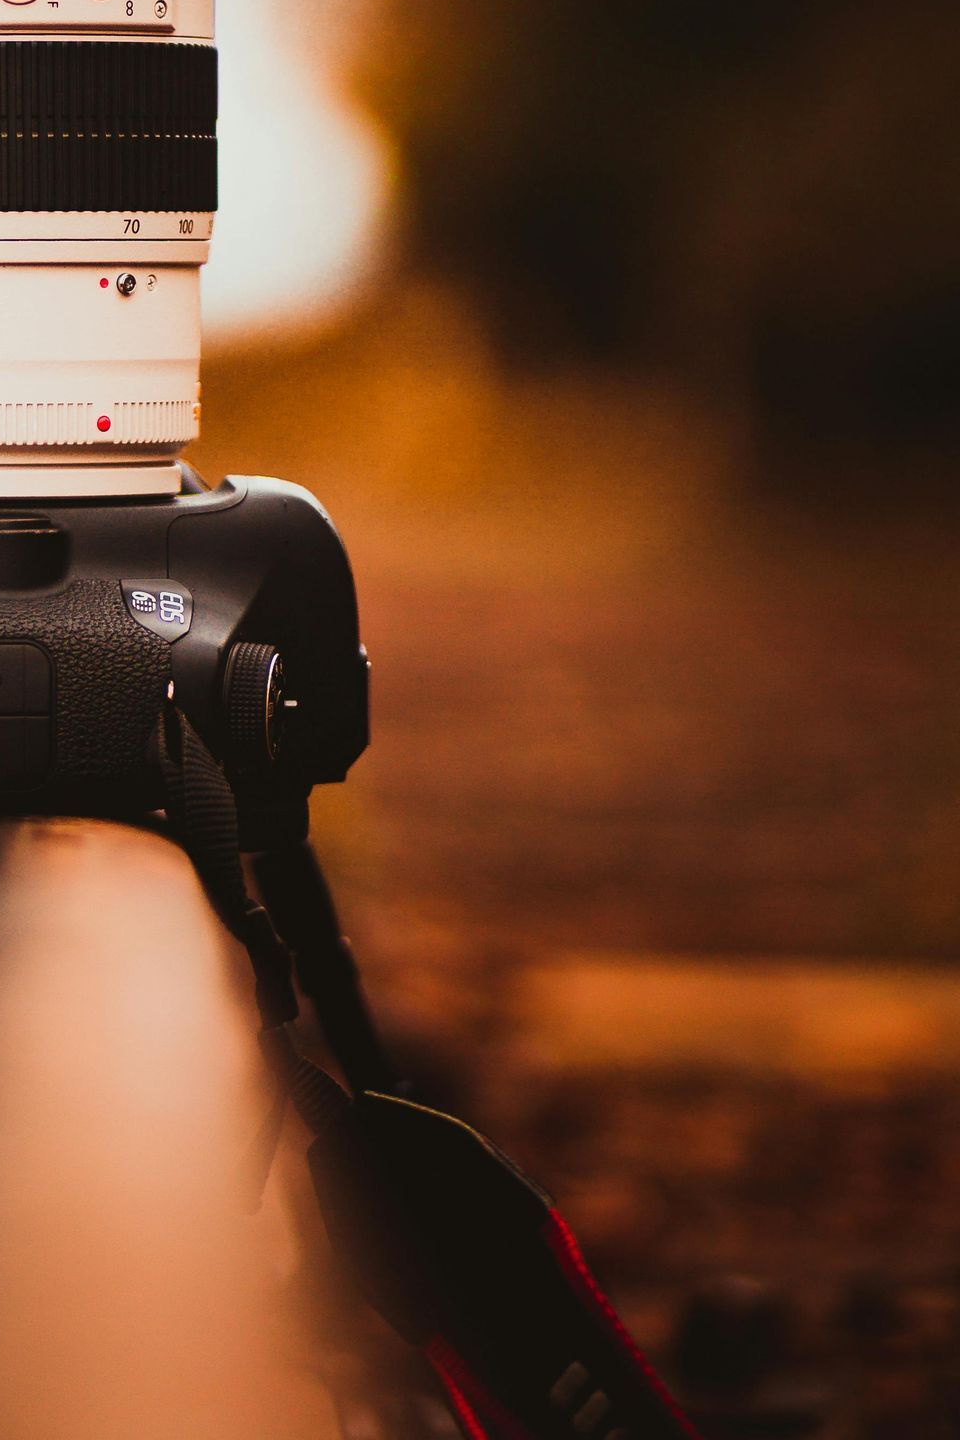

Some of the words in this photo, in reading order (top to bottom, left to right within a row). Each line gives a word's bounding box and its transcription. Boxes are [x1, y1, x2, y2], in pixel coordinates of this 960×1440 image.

[123, 219, 140, 234] 70
[179, 219, 194, 234] 100
[132, 591, 156, 612] 6D
[160, 591, 184, 624] EOS
